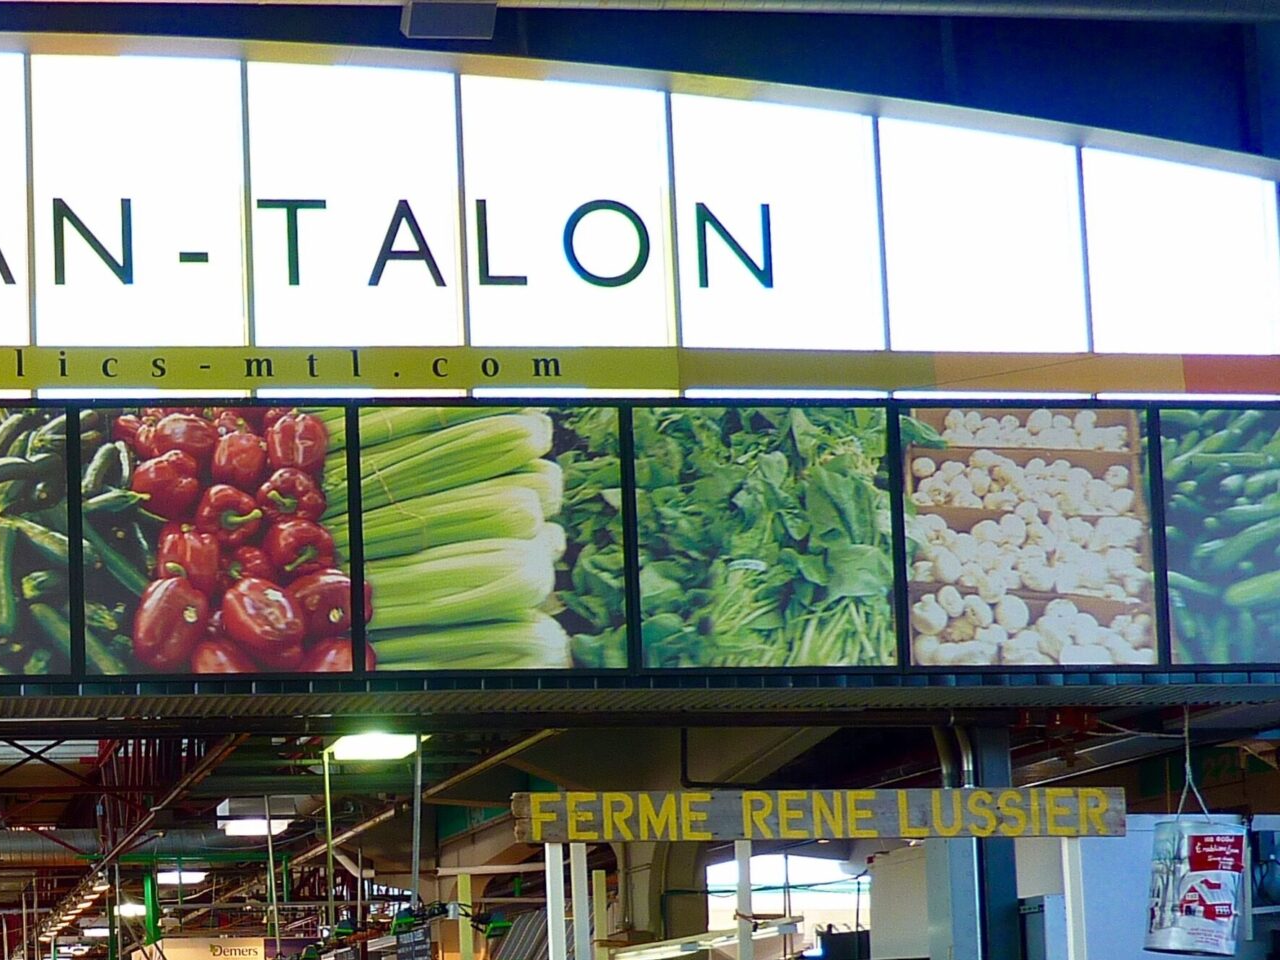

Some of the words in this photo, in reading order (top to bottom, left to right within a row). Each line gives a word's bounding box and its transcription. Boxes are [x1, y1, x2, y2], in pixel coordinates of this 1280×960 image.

[530, 791, 712, 841] FERME
[741, 789, 878, 839] RENE
[898, 787, 1111, 838] LUSSIER
[209, 943, 259, 958] Demers
